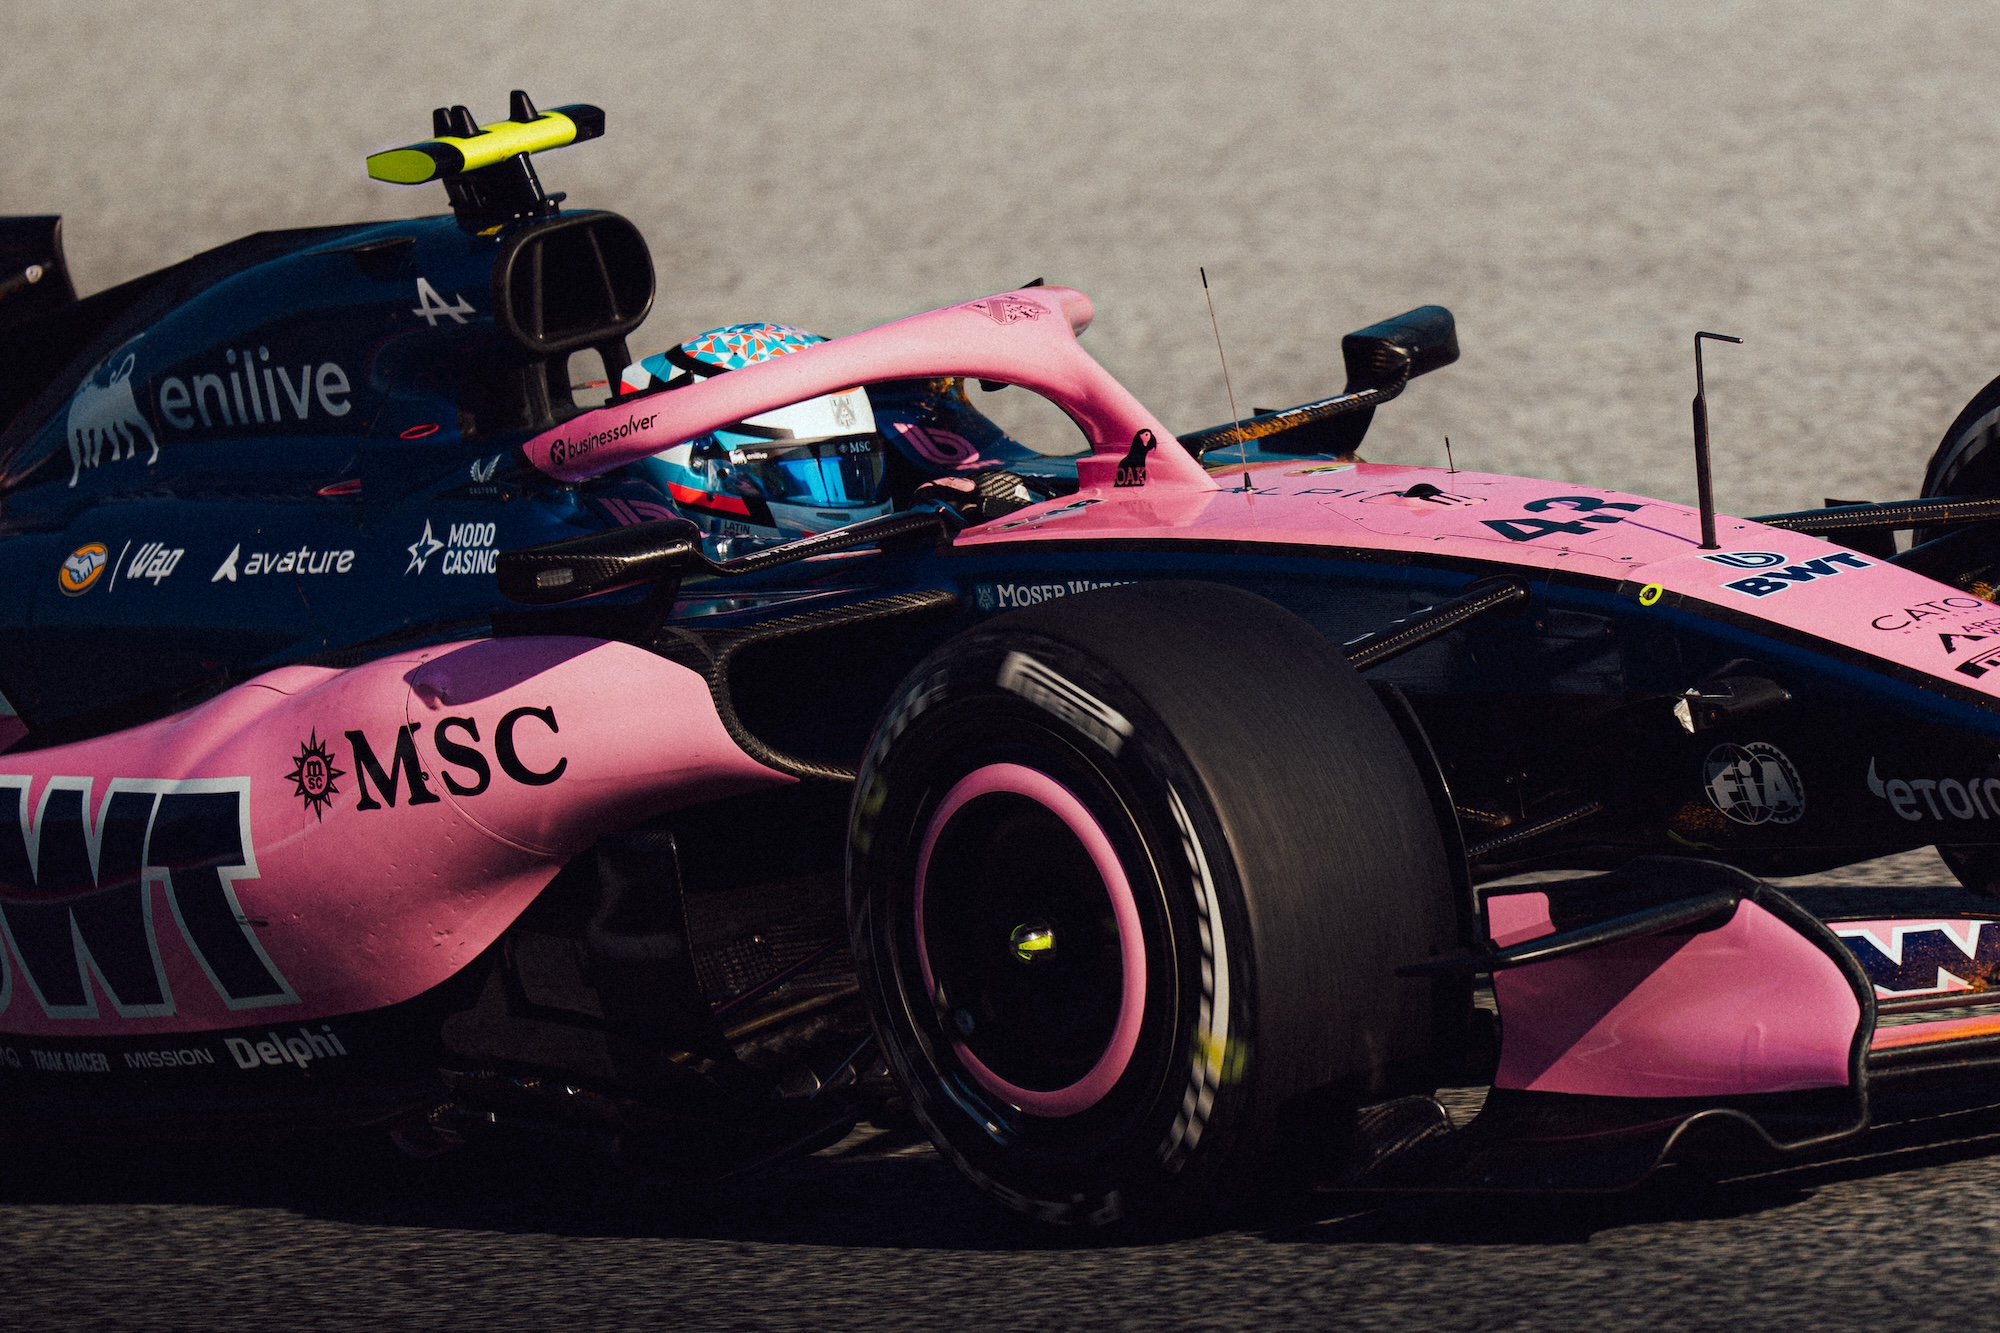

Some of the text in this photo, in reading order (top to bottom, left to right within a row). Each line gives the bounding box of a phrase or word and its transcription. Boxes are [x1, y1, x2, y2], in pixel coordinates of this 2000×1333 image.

[159, 346, 351, 431] enilive
[568, 414, 658, 458] businessolver
[850, 442, 872, 454] MSC
[447, 522, 496, 548] MODO
[1479, 495, 1645, 542] 43
[127, 542, 185, 586] Wap
[244, 545, 355, 575] avature
[442, 549, 500, 575] CASINO
[1719, 550, 1877, 599] BWT
[1871, 598, 1982, 630] CATO
[345, 706, 567, 811] MSC
[0, 775, 302, 1019] WT
[30, 1049, 65, 1072] TRAK
[64, 1051, 110, 1073] RACER
[124, 1048, 215, 1070] MISSION
[224, 1025, 347, 1070] Delphi
